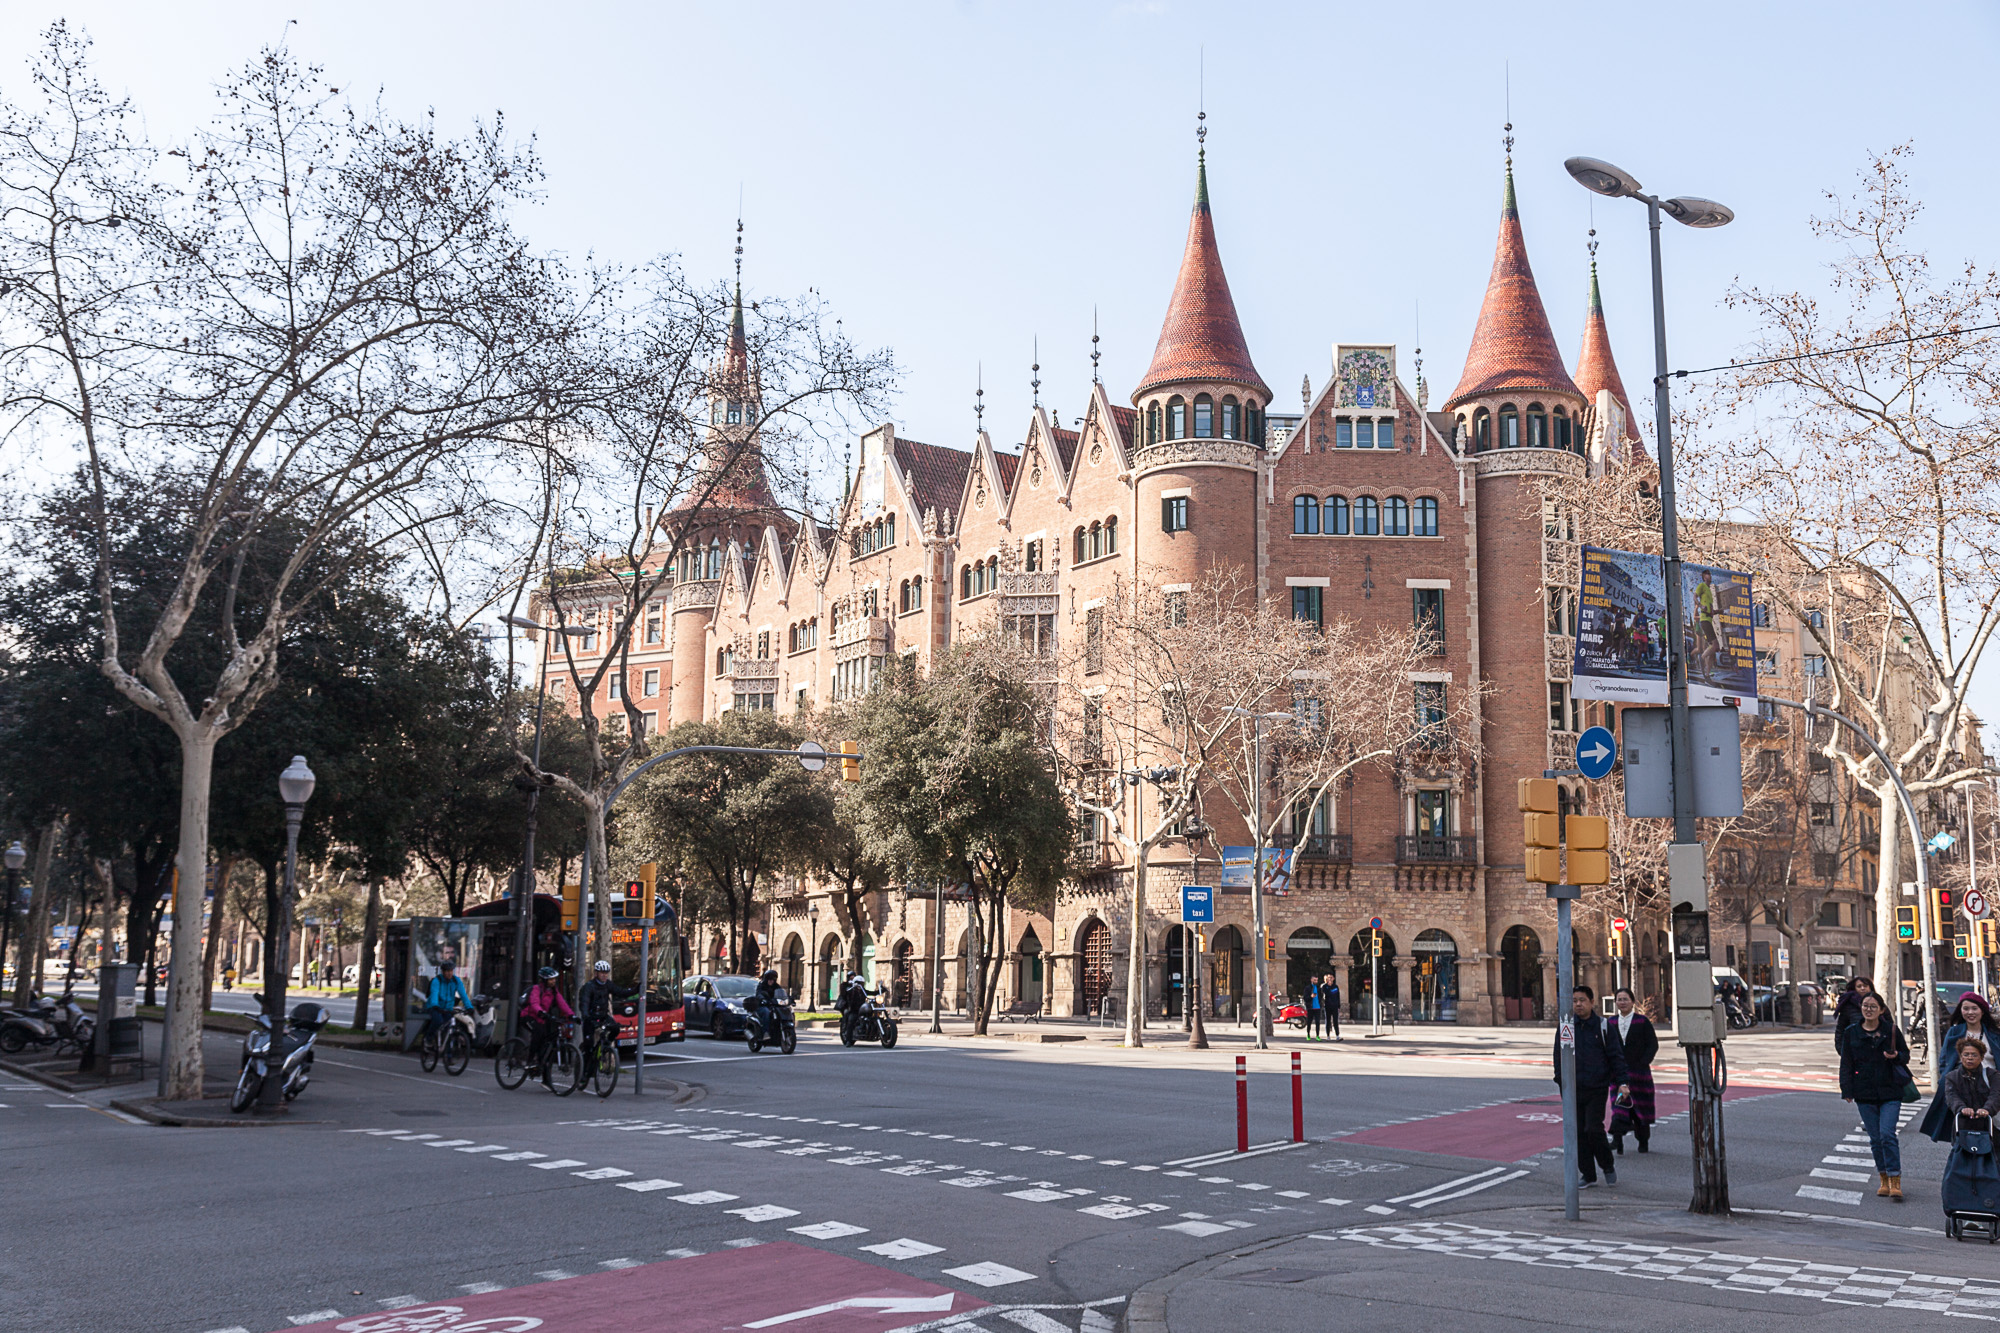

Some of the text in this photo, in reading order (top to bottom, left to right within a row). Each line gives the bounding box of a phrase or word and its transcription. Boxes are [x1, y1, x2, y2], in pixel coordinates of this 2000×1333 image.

[1586, 552, 1612, 563] CORRE
[1585, 562, 1600, 572] PER
[1585, 573, 1601, 584] UNA
[1731, 574, 1749, 585] CREA
[1584, 585, 1605, 596] BONA
[1741, 586, 1749, 596] EL
[1583, 596, 1612, 608] CAUSA!
[1736, 596, 1750, 606] TEU
[1730, 605, 1751, 617] REPTE
[1581, 620, 1592, 631] DE
[1718, 614, 1751, 627] SOLIDARI
[1745, 628, 1752, 637] A
[1580, 632, 1604, 645] MARÇ
[1728, 636, 1752, 648] FAVOR
[1730, 647, 1753, 658] D'UNA
[1592, 662, 1619, 670] BARCELONA
[1737, 658, 1754, 668] ONG
[1594, 685, 1649, 695] migranodearena.org
[1192, 909, 1205, 917] taxi
[646, 1016, 663, 1024] 5404
